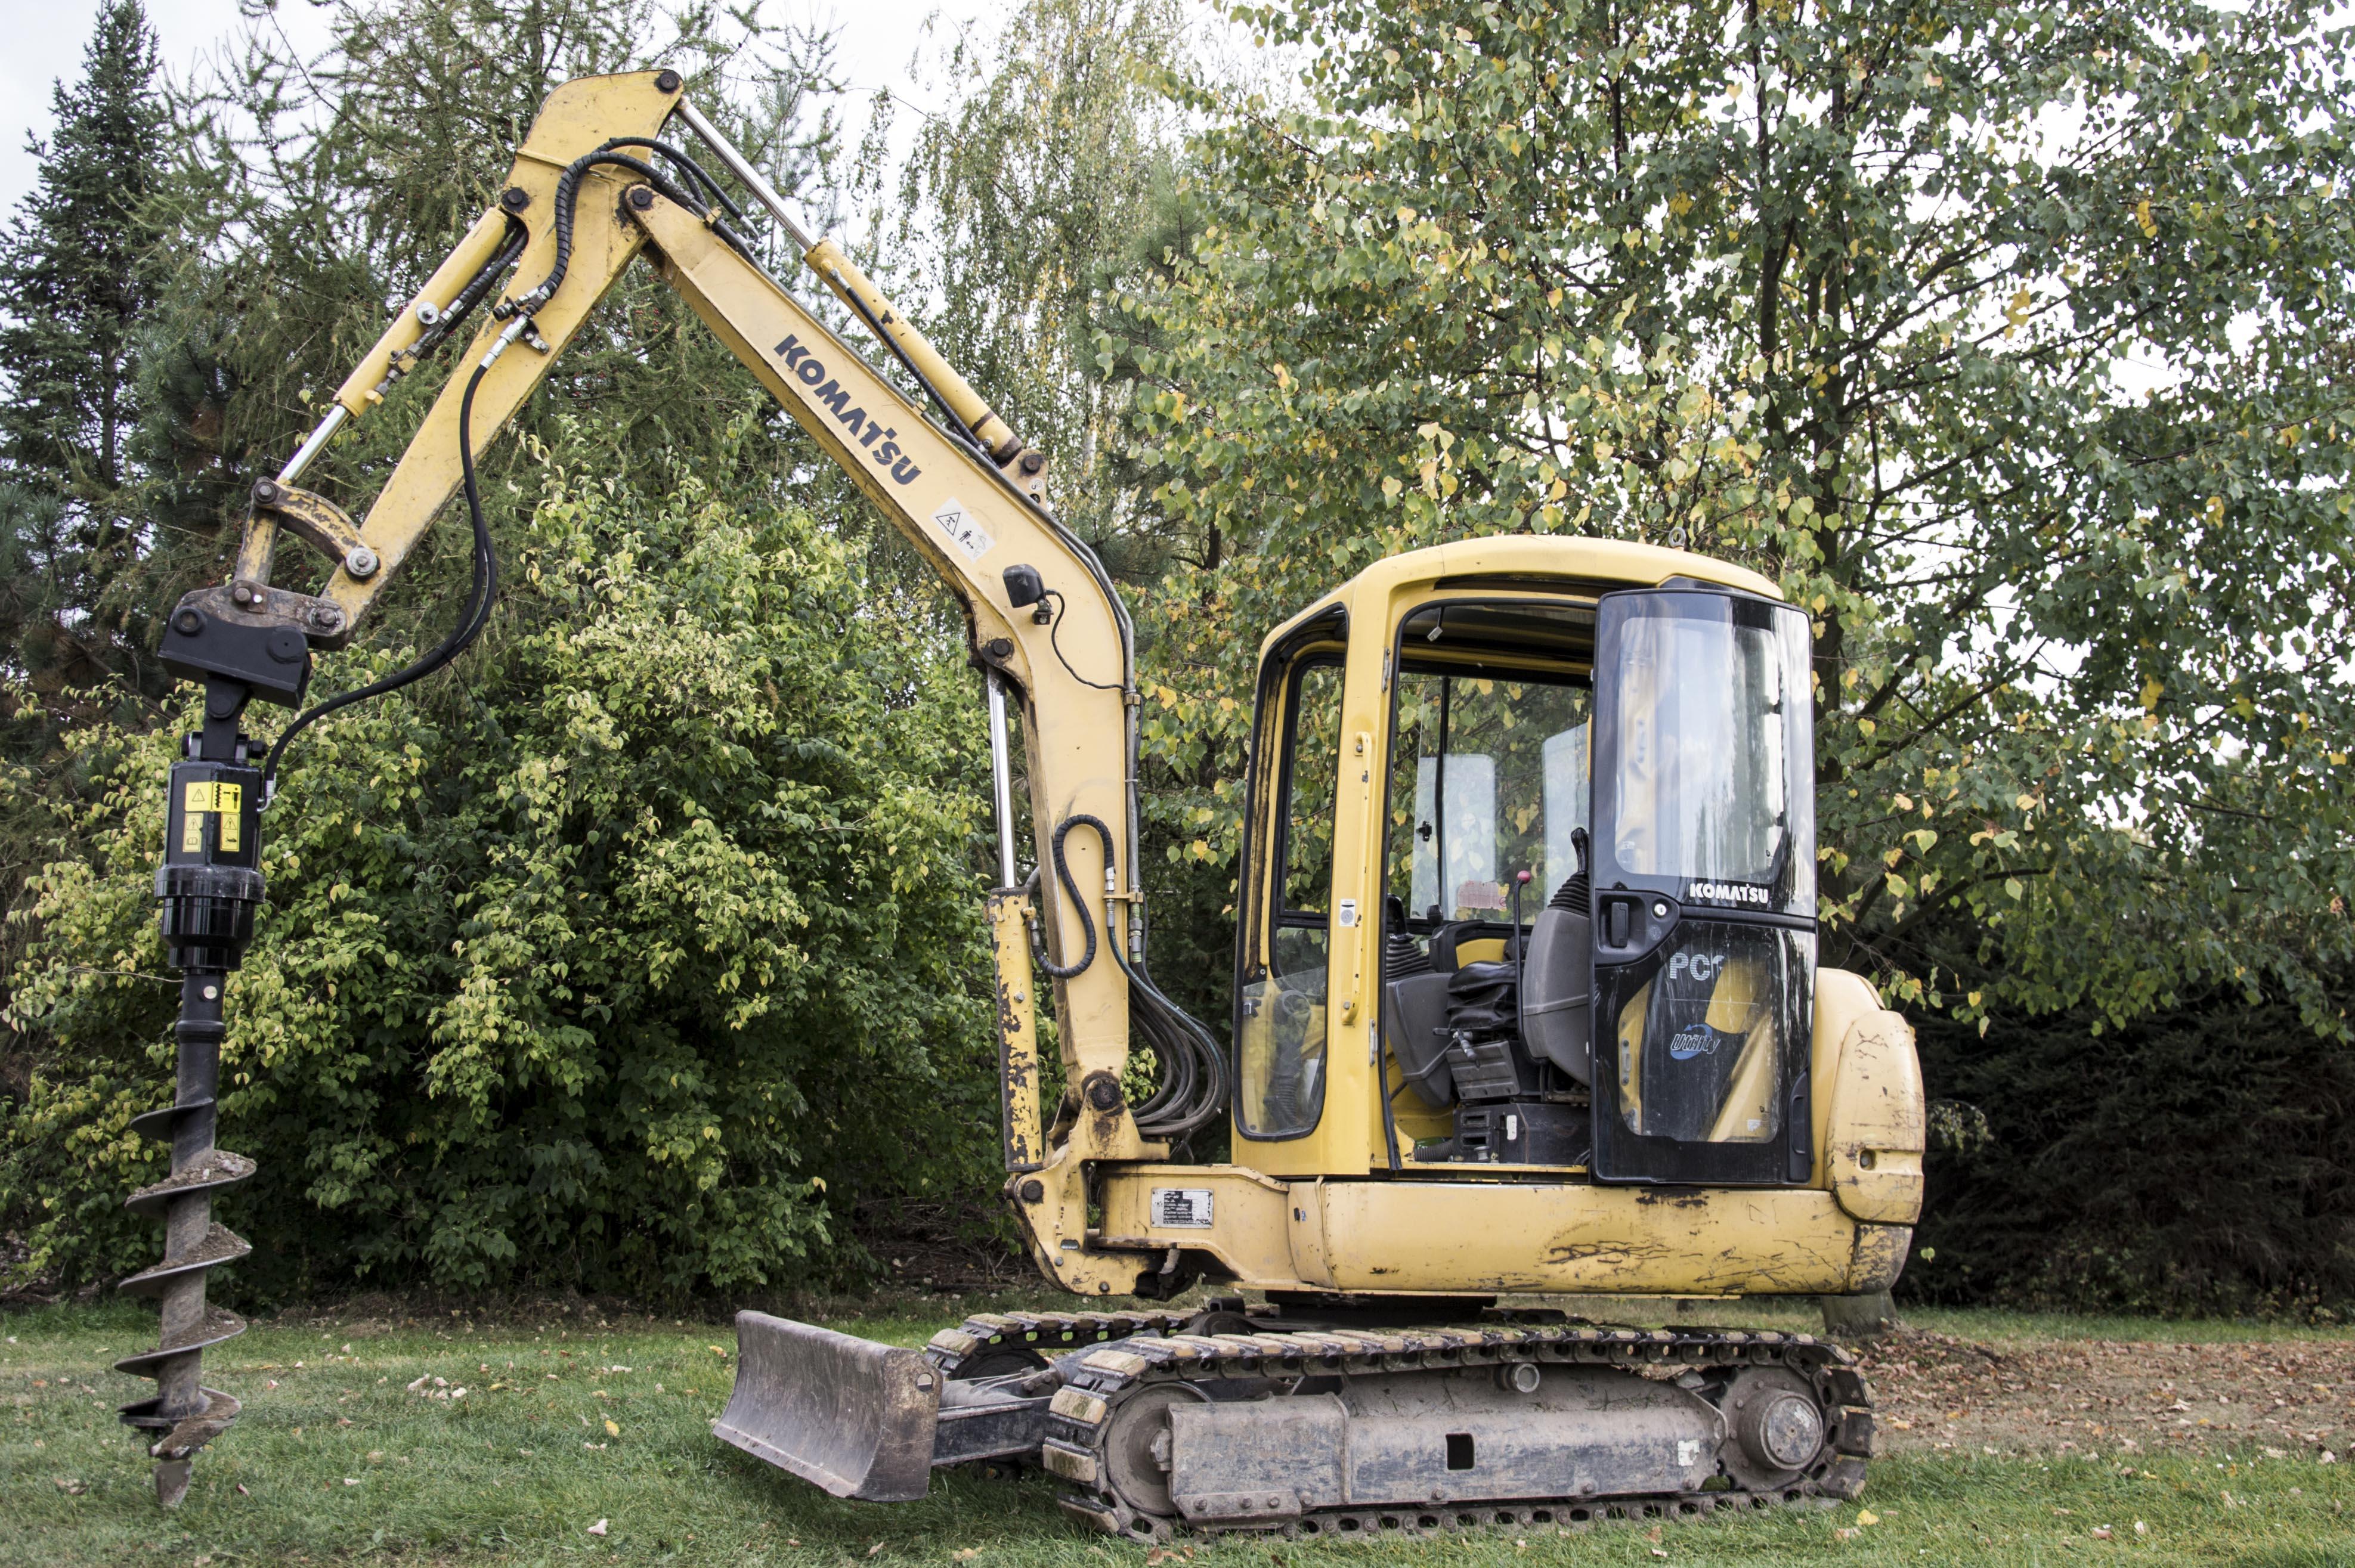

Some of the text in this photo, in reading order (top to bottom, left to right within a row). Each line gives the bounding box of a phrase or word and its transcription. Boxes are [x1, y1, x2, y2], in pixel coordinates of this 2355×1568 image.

[773, 333, 921, 485] KOMATSU
[1689, 883, 1768, 903] KOMATSU
[1670, 1034, 1721, 1054] Utility
